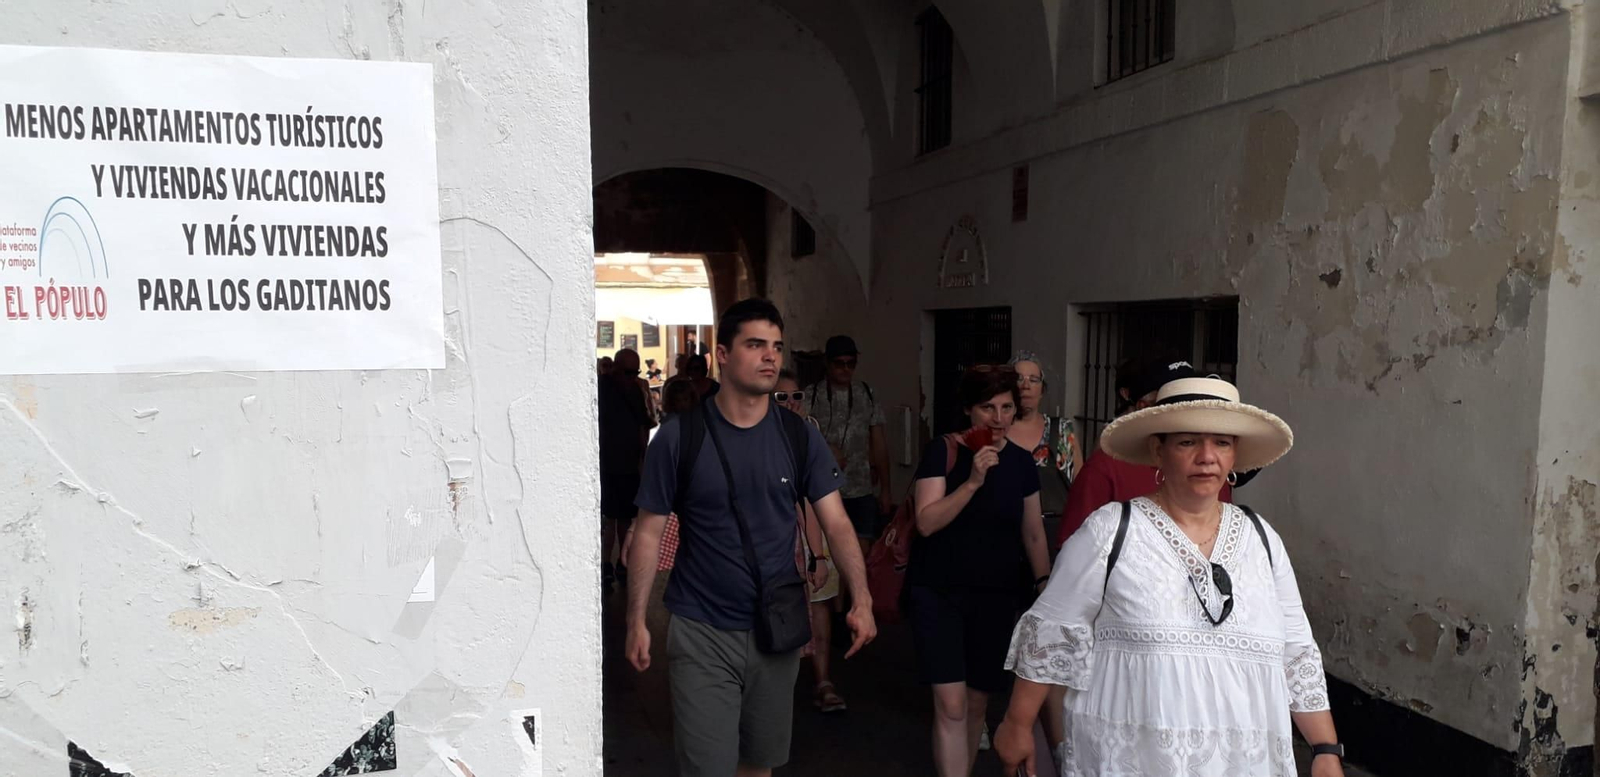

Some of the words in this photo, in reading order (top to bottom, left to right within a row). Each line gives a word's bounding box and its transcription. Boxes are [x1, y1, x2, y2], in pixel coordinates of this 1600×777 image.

[5, 103, 86, 140] MENOS
[91, 106, 261, 146] APARTAMENTOS
[266, 105, 383, 149] TURÍSTICOS
[91, 164, 105, 198] Y
[110, 165, 227, 201] VIVIENDAS
[231, 168, 386, 204] VACACIONALES
[9, 239, 37, 251] vecinos
[182, 223, 197, 256] Y
[204, 214, 256, 256] MÁS
[261, 225, 388, 258] VIVIENDAS
[8, 254, 36, 271] amigos
[4, 286, 30, 320] EL
[34, 277, 107, 320] PÓPULO
[138, 278, 203, 311] PARA
[207, 278, 251, 311] LOS
[256, 278, 391, 312] GADITANOS
